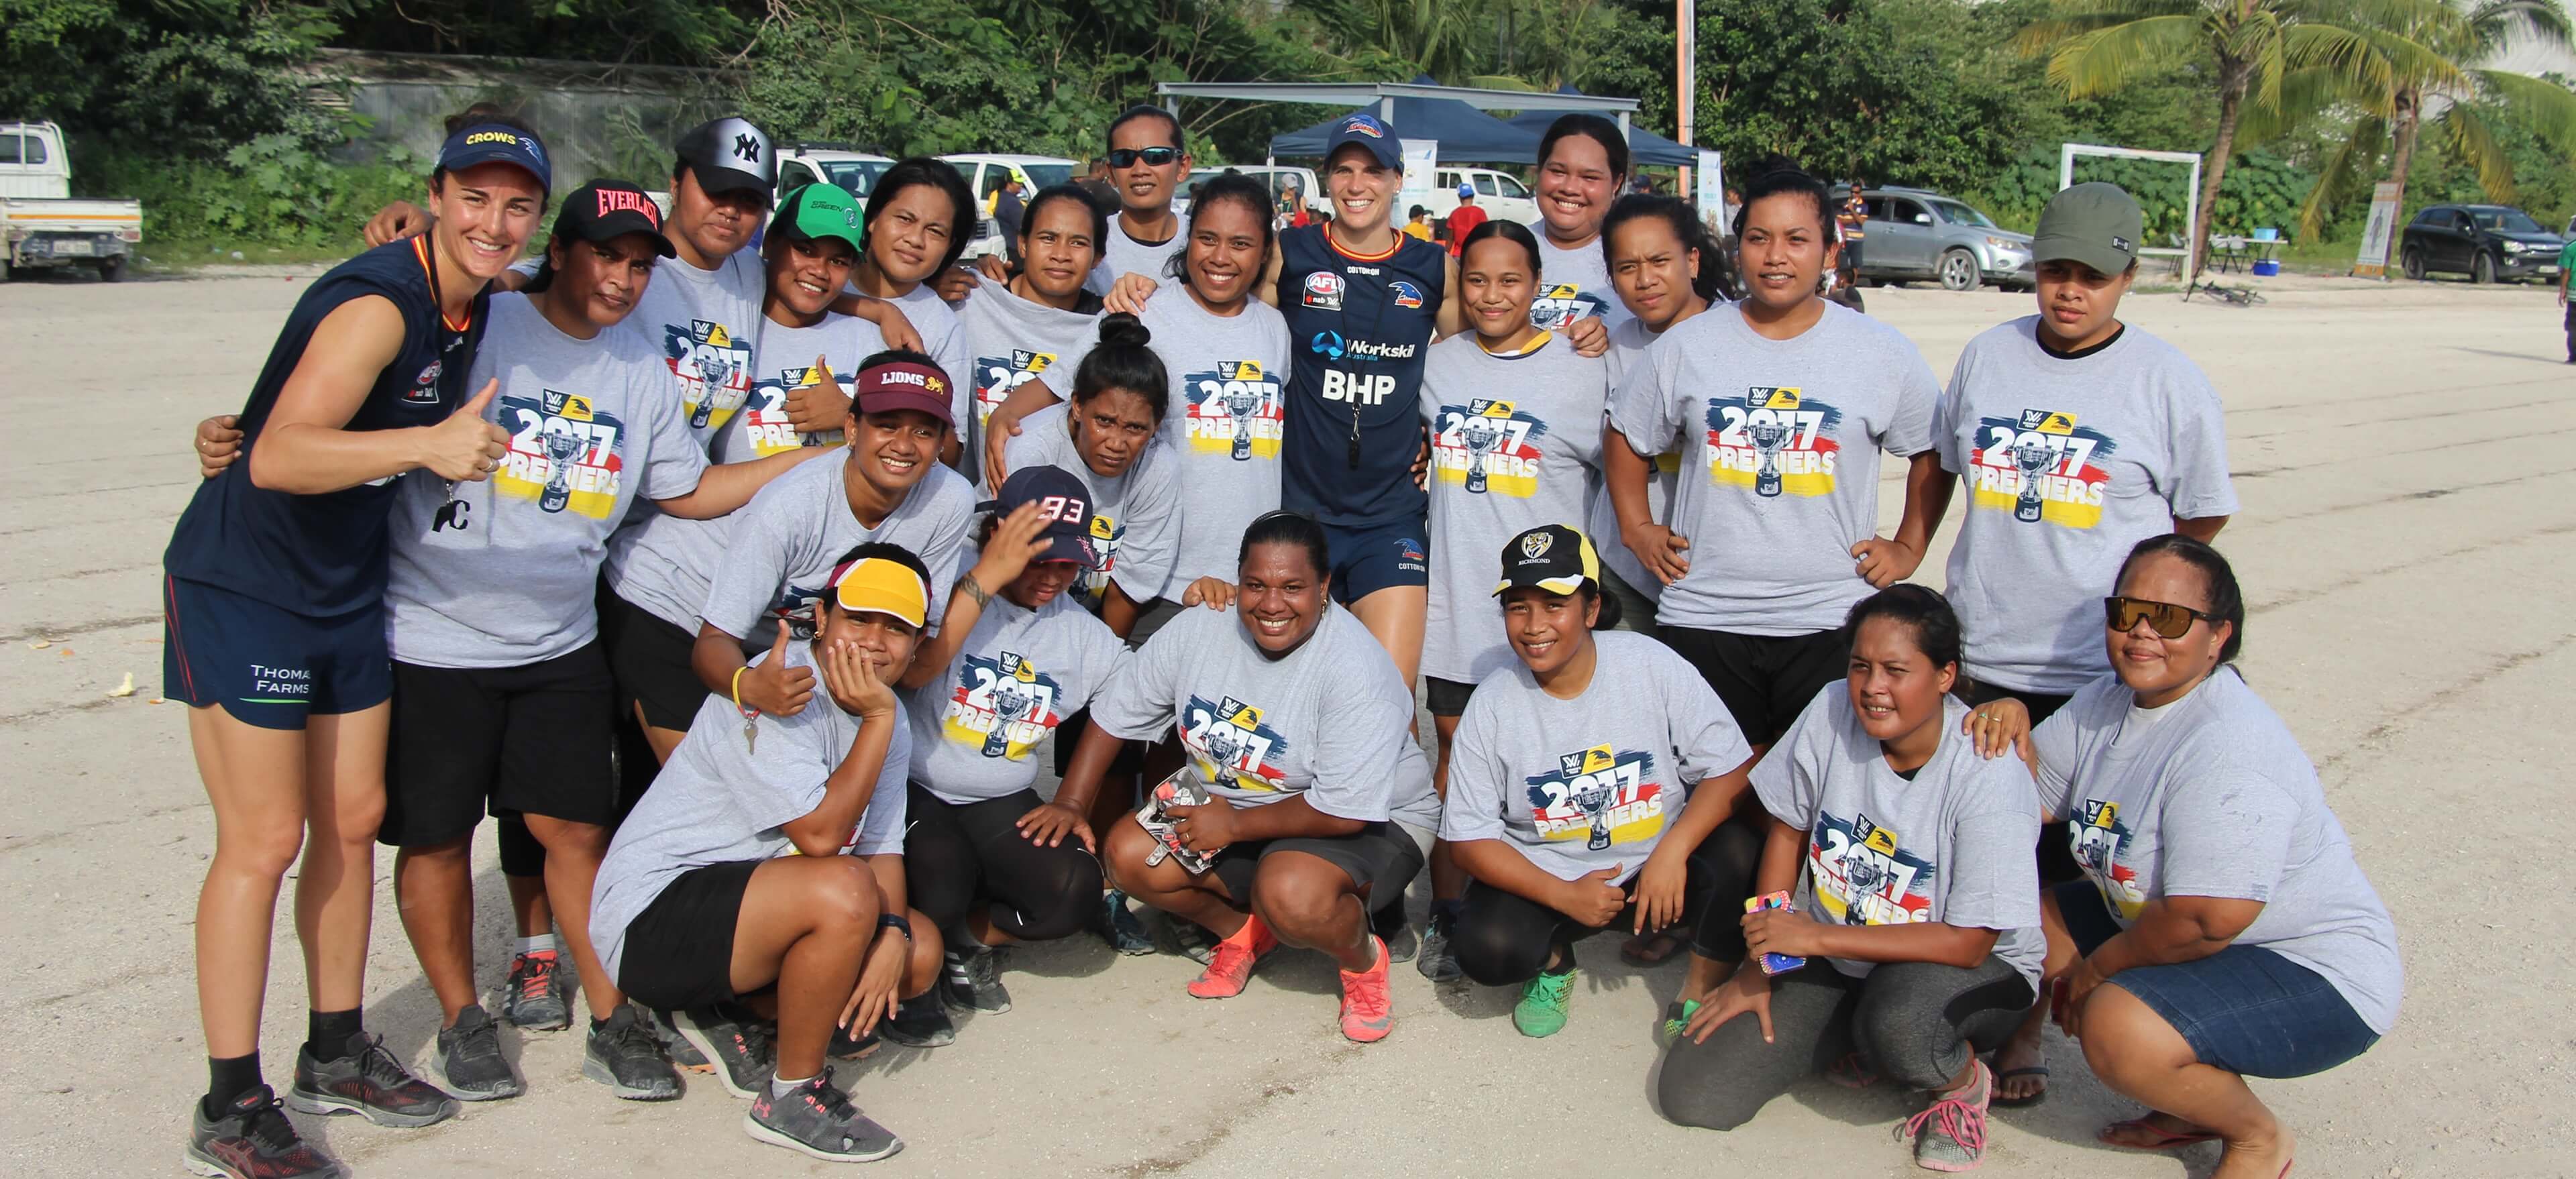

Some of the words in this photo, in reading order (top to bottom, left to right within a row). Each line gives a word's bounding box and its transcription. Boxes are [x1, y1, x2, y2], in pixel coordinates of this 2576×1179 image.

[466, 131, 517, 146] CROWS
[733, 132, 761, 164] NY
[1309, 276, 1338, 290] AFL
[1346, 339, 1415, 357] Workskil
[881, 372, 925, 386] LIONS
[1322, 369, 1396, 405] BHP
[1198, 380, 1279, 417] 2017
[511, 408, 618, 467] 2017
[1440, 412, 1533, 455] 2017
[1719, 406, 1825, 450] 2017
[1982, 426, 2098, 478] 2017
[1038, 495, 1085, 526] 93
[1518, 558, 1551, 567] RICHMOND
[250, 664, 311, 680] THOMA
[256, 679, 310, 694] FARMS
[965, 667, 1053, 724] 2017
[1186, 708, 1273, 773] 2017
[1540, 760, 1641, 820] 2017
[1819, 828, 1918, 905] 2017
